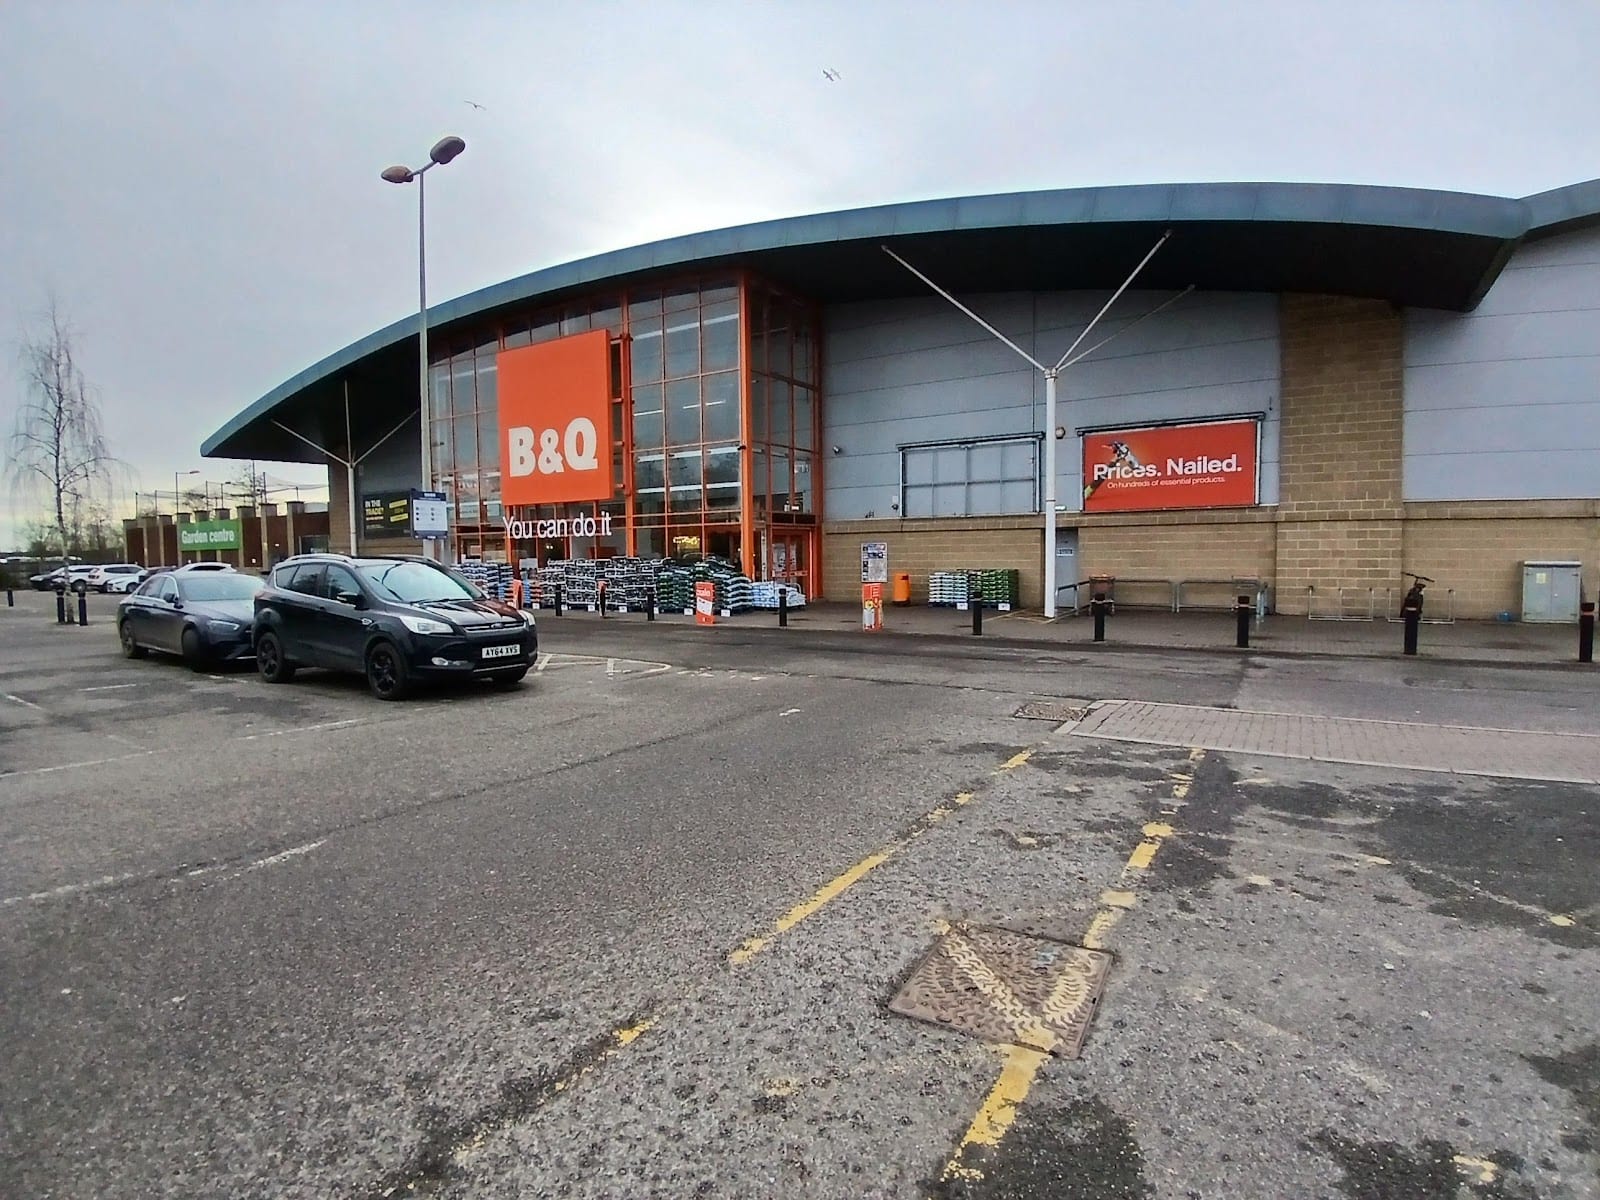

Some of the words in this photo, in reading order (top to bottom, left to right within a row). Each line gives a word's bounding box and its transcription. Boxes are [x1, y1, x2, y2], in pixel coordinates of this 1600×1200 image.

[508, 417, 598, 477] B&Q
[1093, 462, 1162, 481] Prices.
[1166, 454, 1243, 476] Nailed.
[1107, 481, 1118, 489] On
[1118, 480, 1150, 488] hundreds
[1152, 478, 1159, 486] of
[1160, 477, 1191, 486] essential
[181, 530, 208, 544] Garden
[209, 528, 234, 542] centre
[503, 515, 533, 539] You
[537, 519, 568, 538] can
[572, 511, 597, 537] do
[601, 511, 612, 536] it
